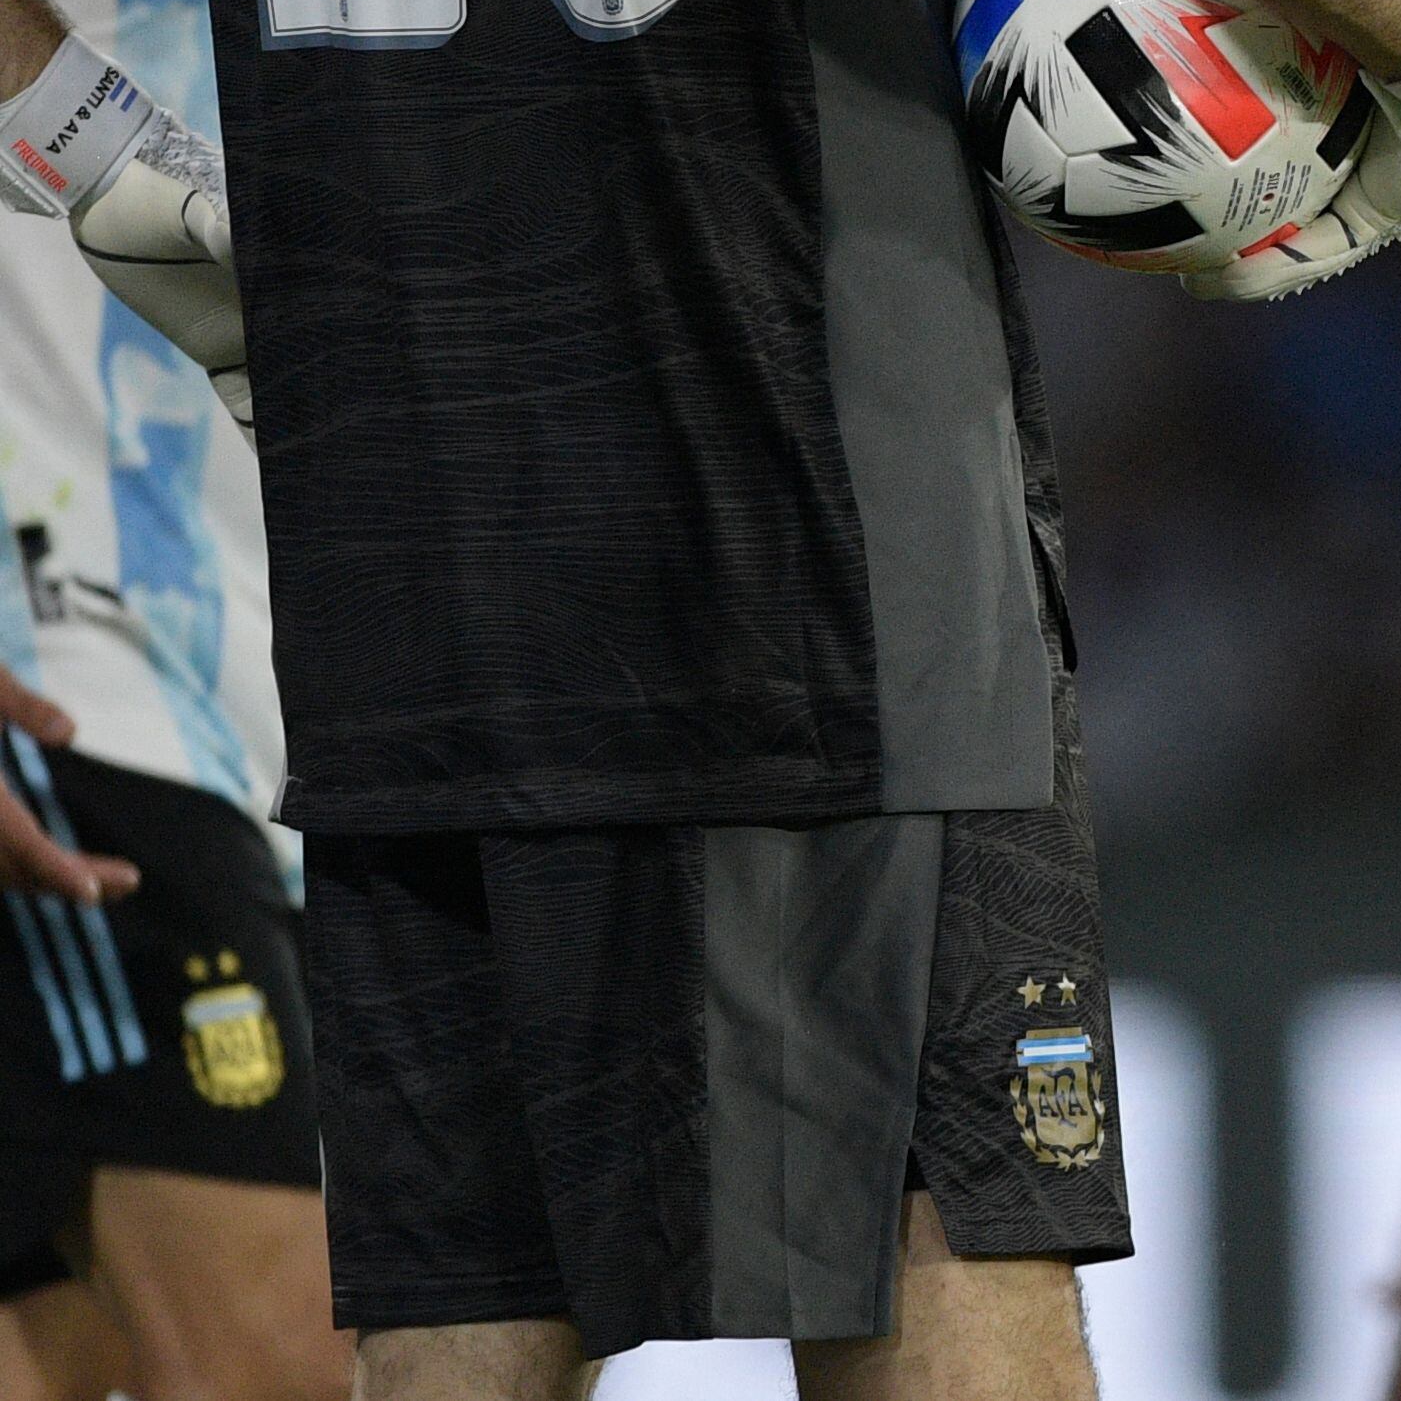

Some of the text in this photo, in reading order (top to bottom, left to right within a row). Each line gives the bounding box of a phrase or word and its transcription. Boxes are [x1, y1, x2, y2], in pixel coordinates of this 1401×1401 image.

[87, 66, 120, 109] SANTI
[46, 122, 79, 155] AVA
[10, 138, 70, 193] PREDATOR
